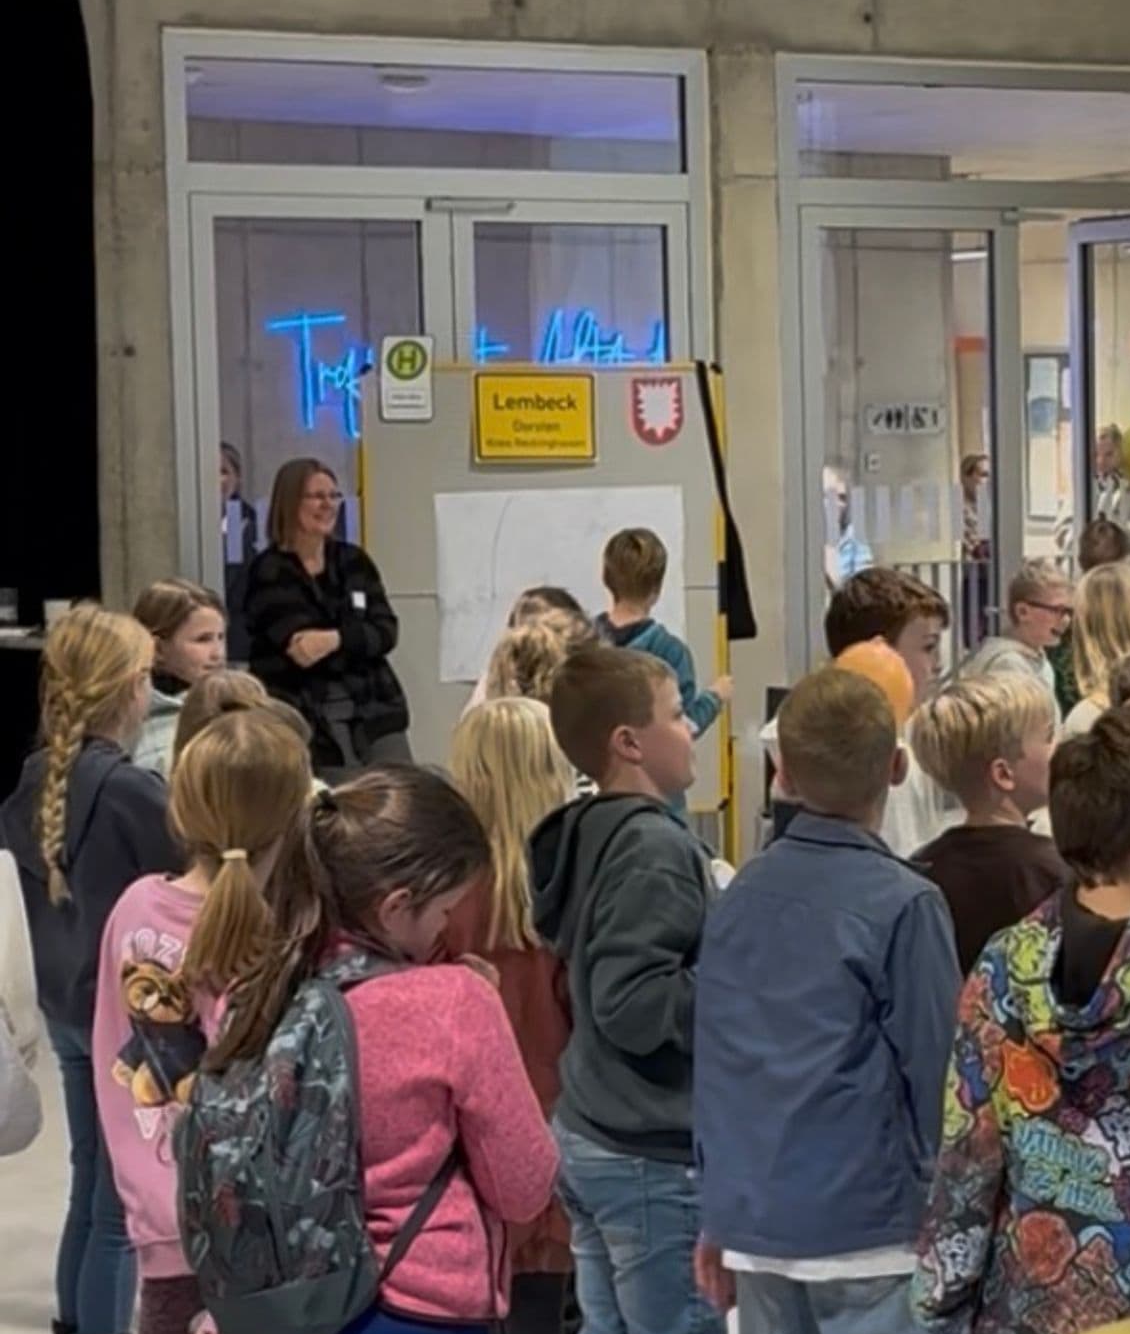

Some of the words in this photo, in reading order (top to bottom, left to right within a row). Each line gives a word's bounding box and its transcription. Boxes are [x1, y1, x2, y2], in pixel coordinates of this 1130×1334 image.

[398, 349, 418, 371] H
[493, 392, 578, 412] Lembeck
[512, 419, 562, 433] Dorsten
